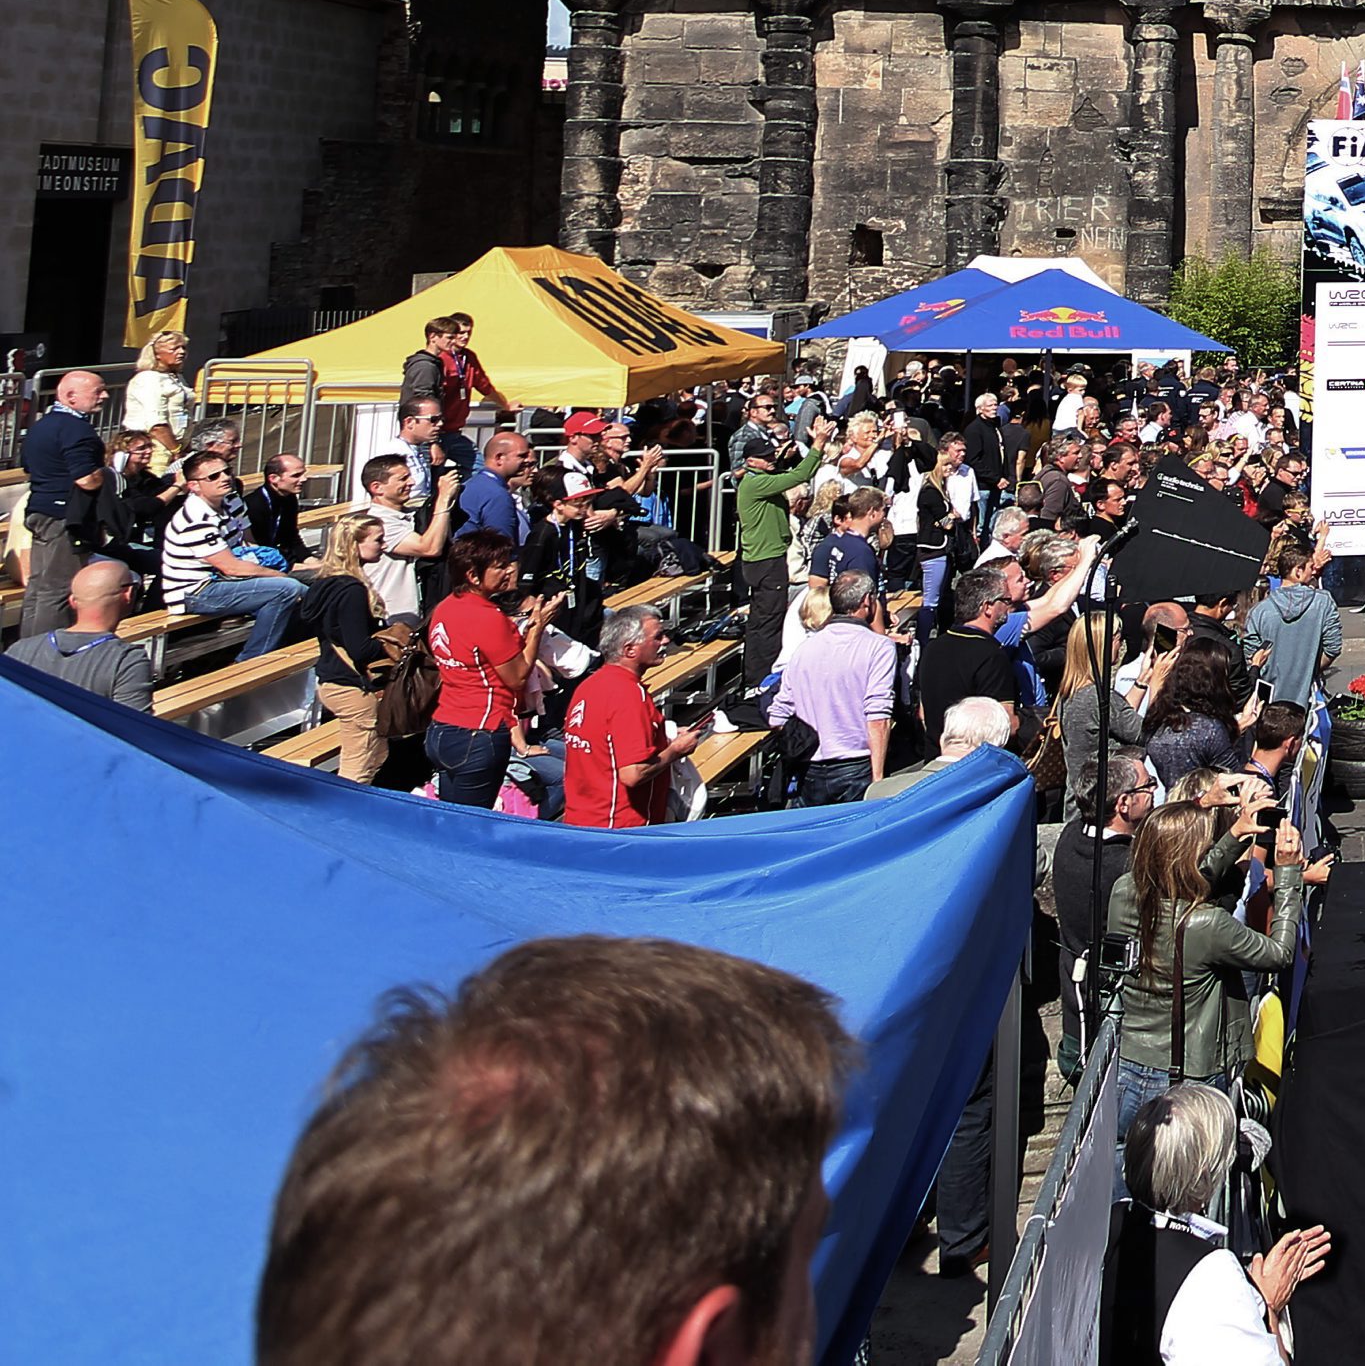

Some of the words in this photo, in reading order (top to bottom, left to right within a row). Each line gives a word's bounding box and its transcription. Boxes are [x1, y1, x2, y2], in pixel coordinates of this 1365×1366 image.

[135, 45, 210, 317] ADAC
[1009, 325, 1064, 339] Red
[1069, 325, 1120, 339] Bull
